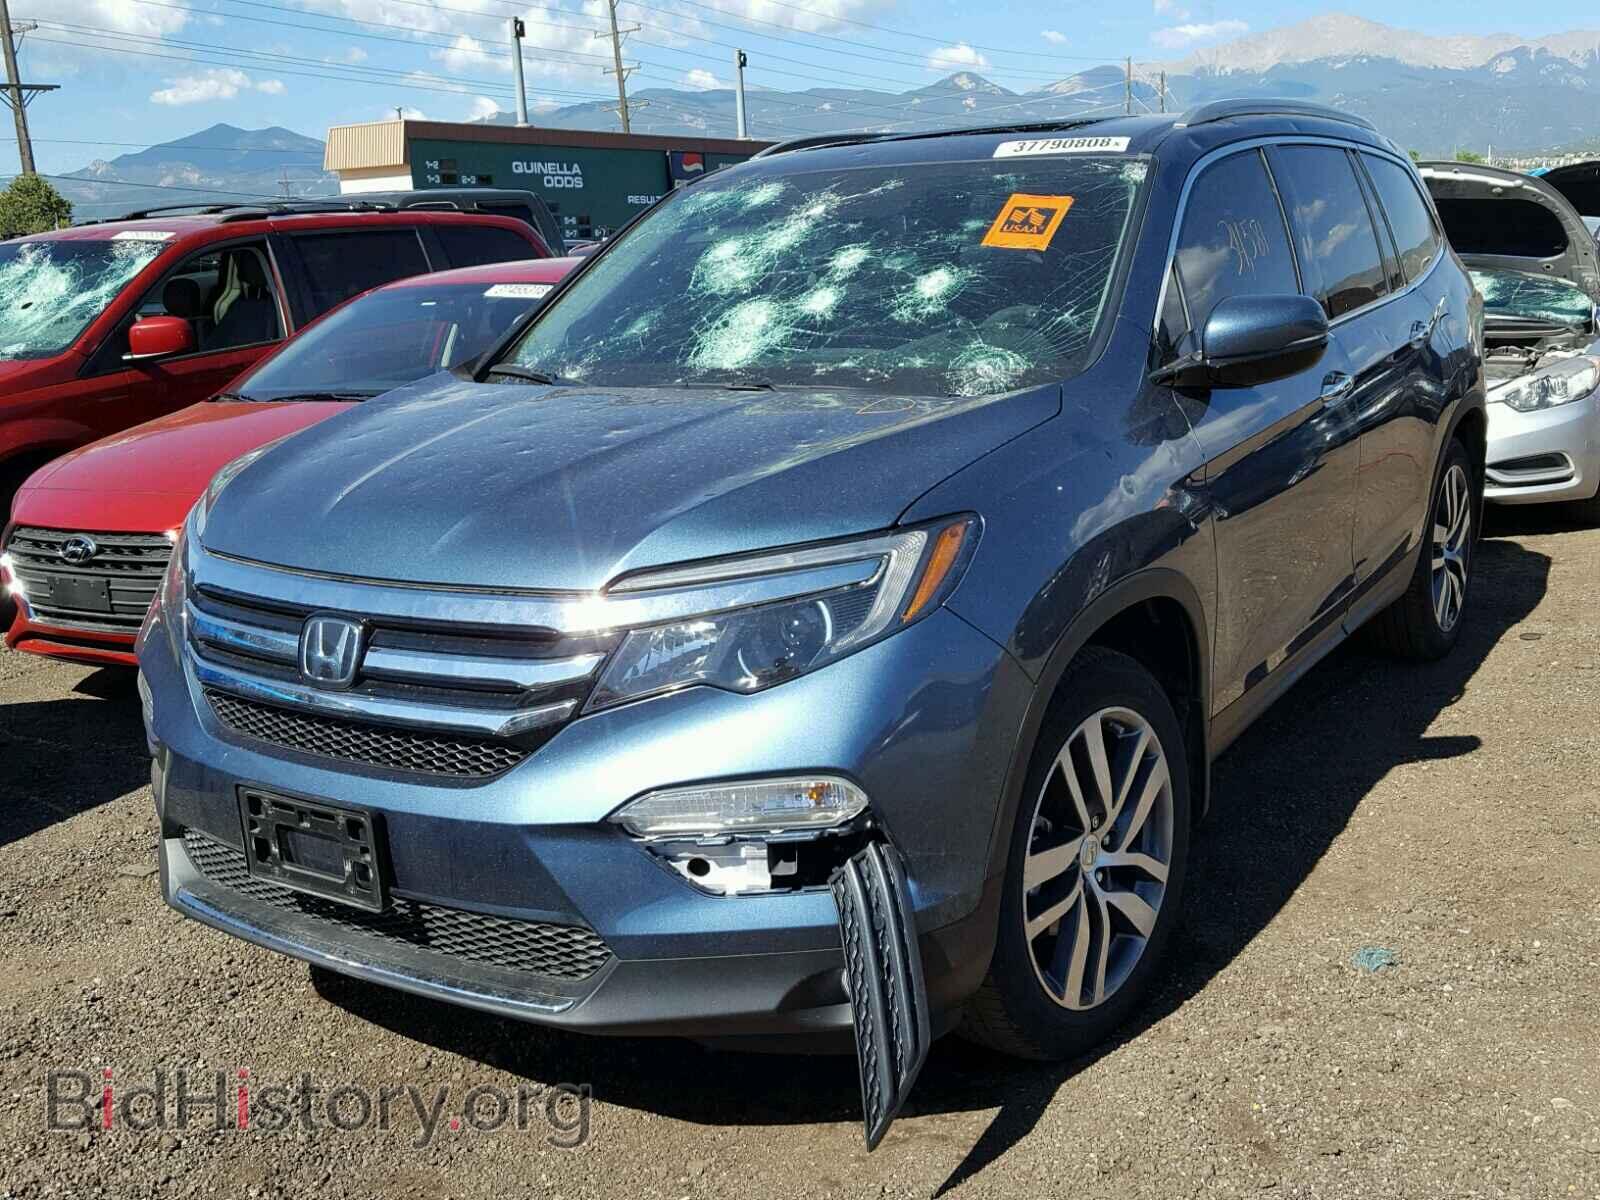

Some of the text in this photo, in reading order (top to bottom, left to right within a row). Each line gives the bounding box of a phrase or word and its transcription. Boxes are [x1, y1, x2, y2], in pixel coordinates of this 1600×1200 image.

[1013, 138, 1111, 152] 37790808
[512, 161, 582, 175] QUINELLA
[544, 175, 583, 188] ODDS
[1002, 223, 1037, 233] USAA
